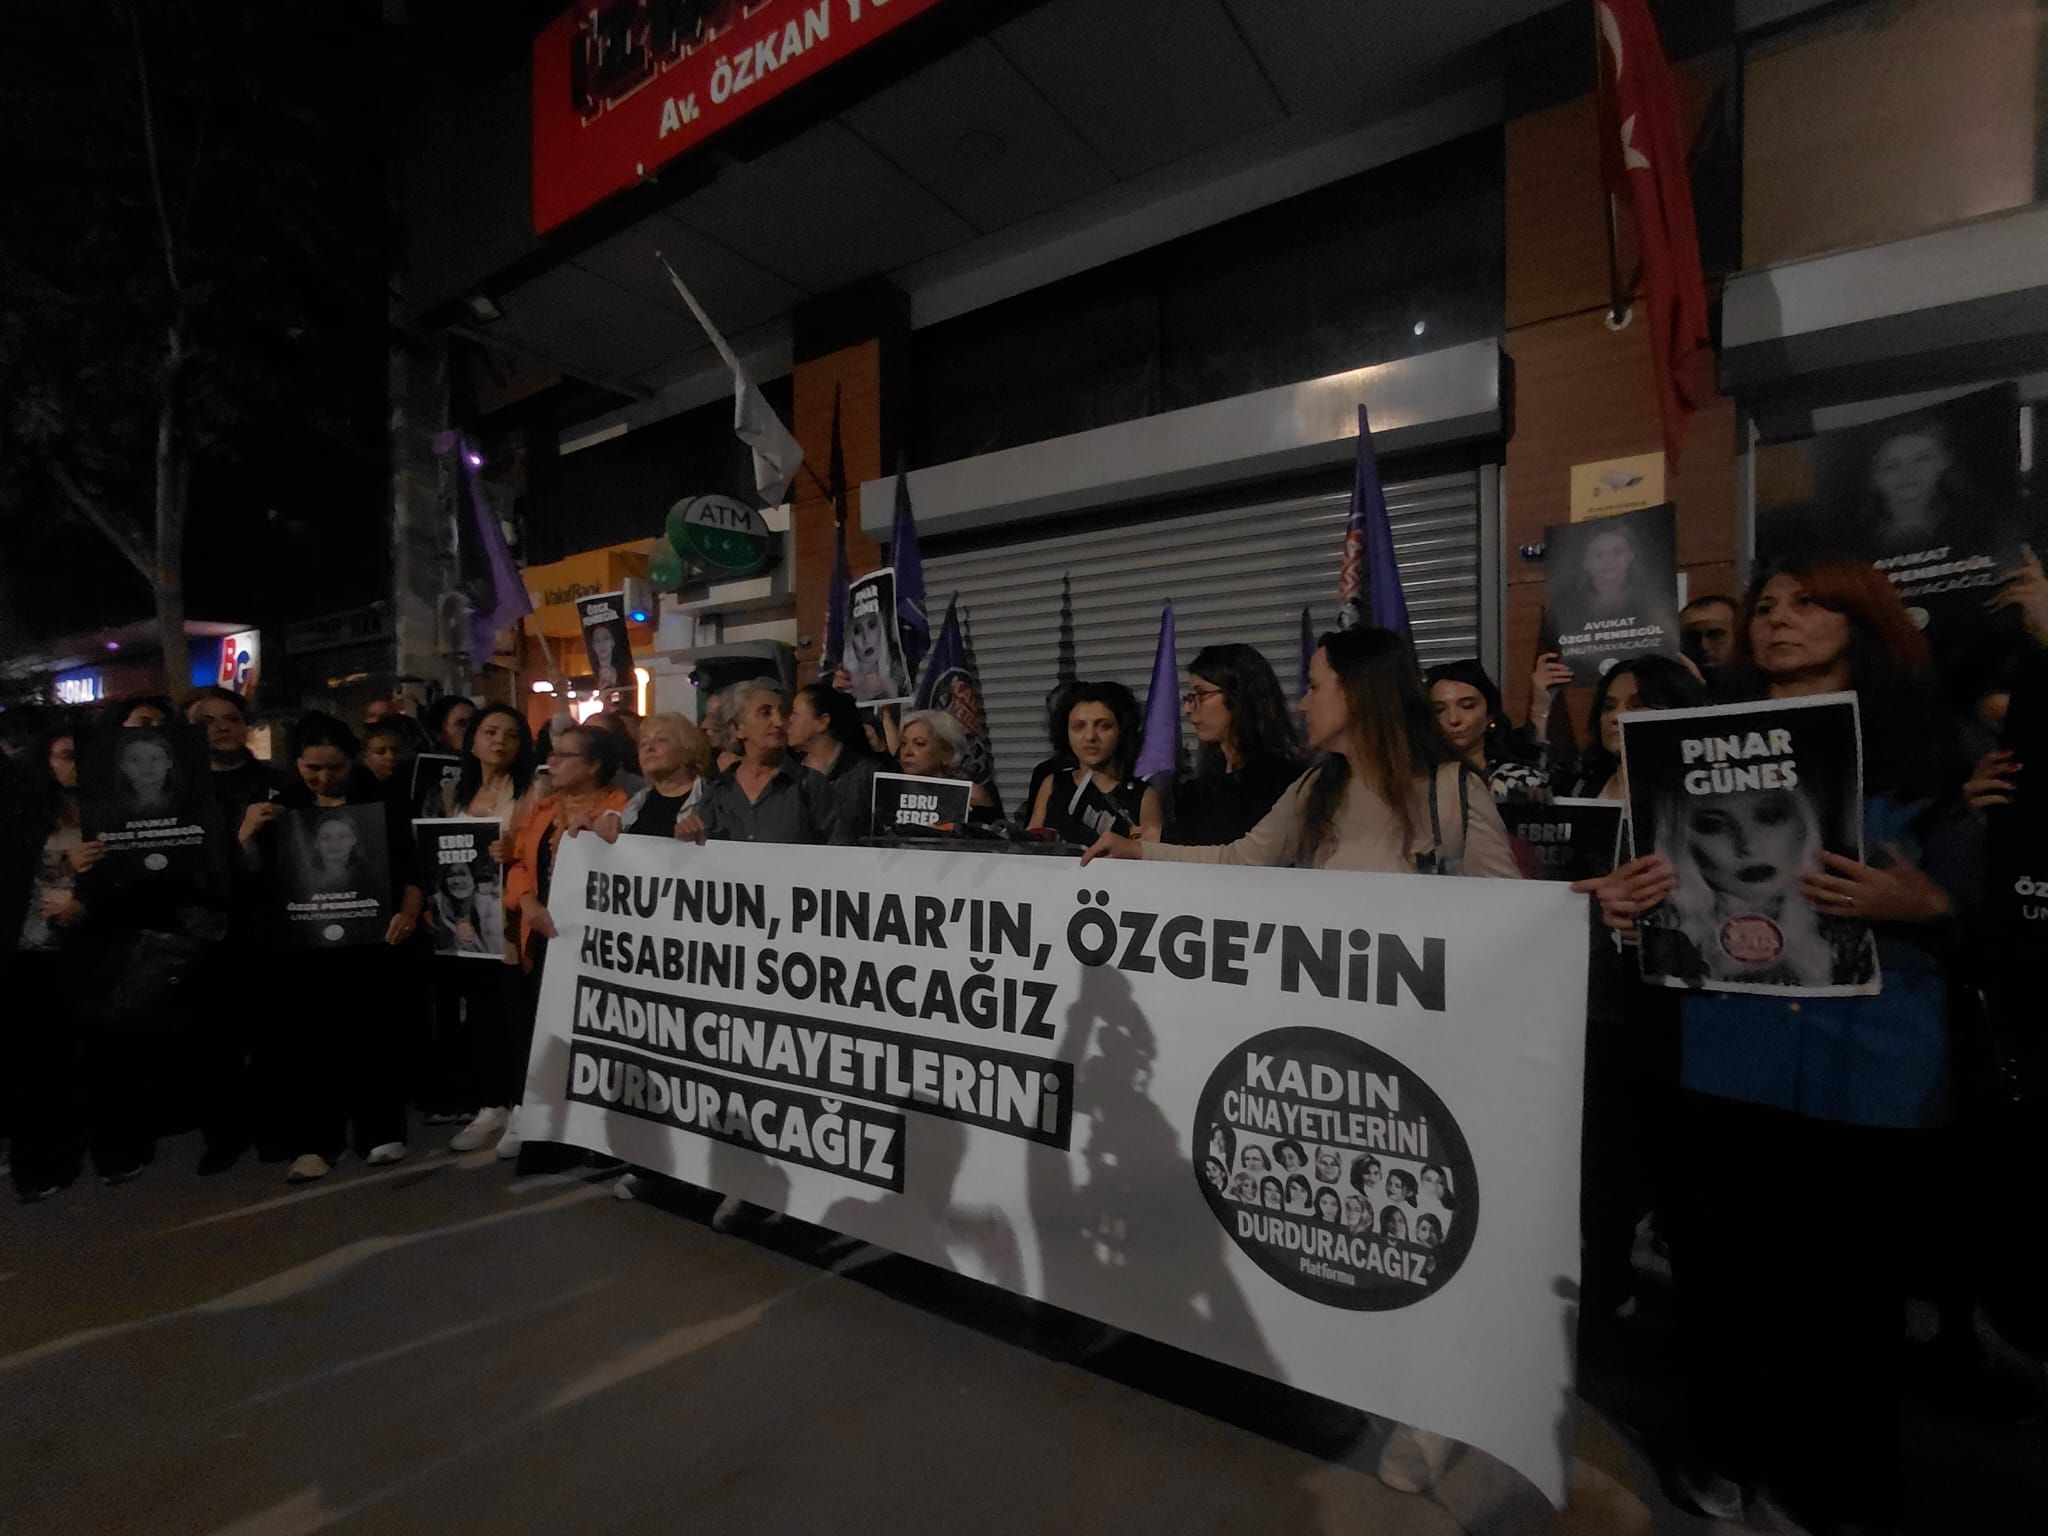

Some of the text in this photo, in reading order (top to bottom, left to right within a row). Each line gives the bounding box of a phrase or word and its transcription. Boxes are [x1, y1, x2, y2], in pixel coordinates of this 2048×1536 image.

[658, 0, 830, 141] Av. ÖZKAN
[700, 503, 752, 530] ATM
[1583, 616, 1637, 631] AVUKAT
[1680, 728, 1795, 764] PINAR
[1684, 760, 1799, 796] GÜNEŞ
[900, 793, 938, 811] EBRU
[585, 870, 781, 940] EBRU'NUN,
[792, 886, 1052, 971] PINAR'IN,
[580, 924, 1058, 1041] HESABINI SORACAĞIZ
[577, 984, 687, 1052] KADIN
[1246, 1051, 1400, 1112] KADIN
[571, 1051, 897, 1181] DURDURACAĞIZ
[1223, 1085, 1429, 1158] CİNAYETLERİNİ
[1237, 1209, 1429, 1286] DURDURACAĞIZ
[1300, 1256, 1356, 1286] Platformu
